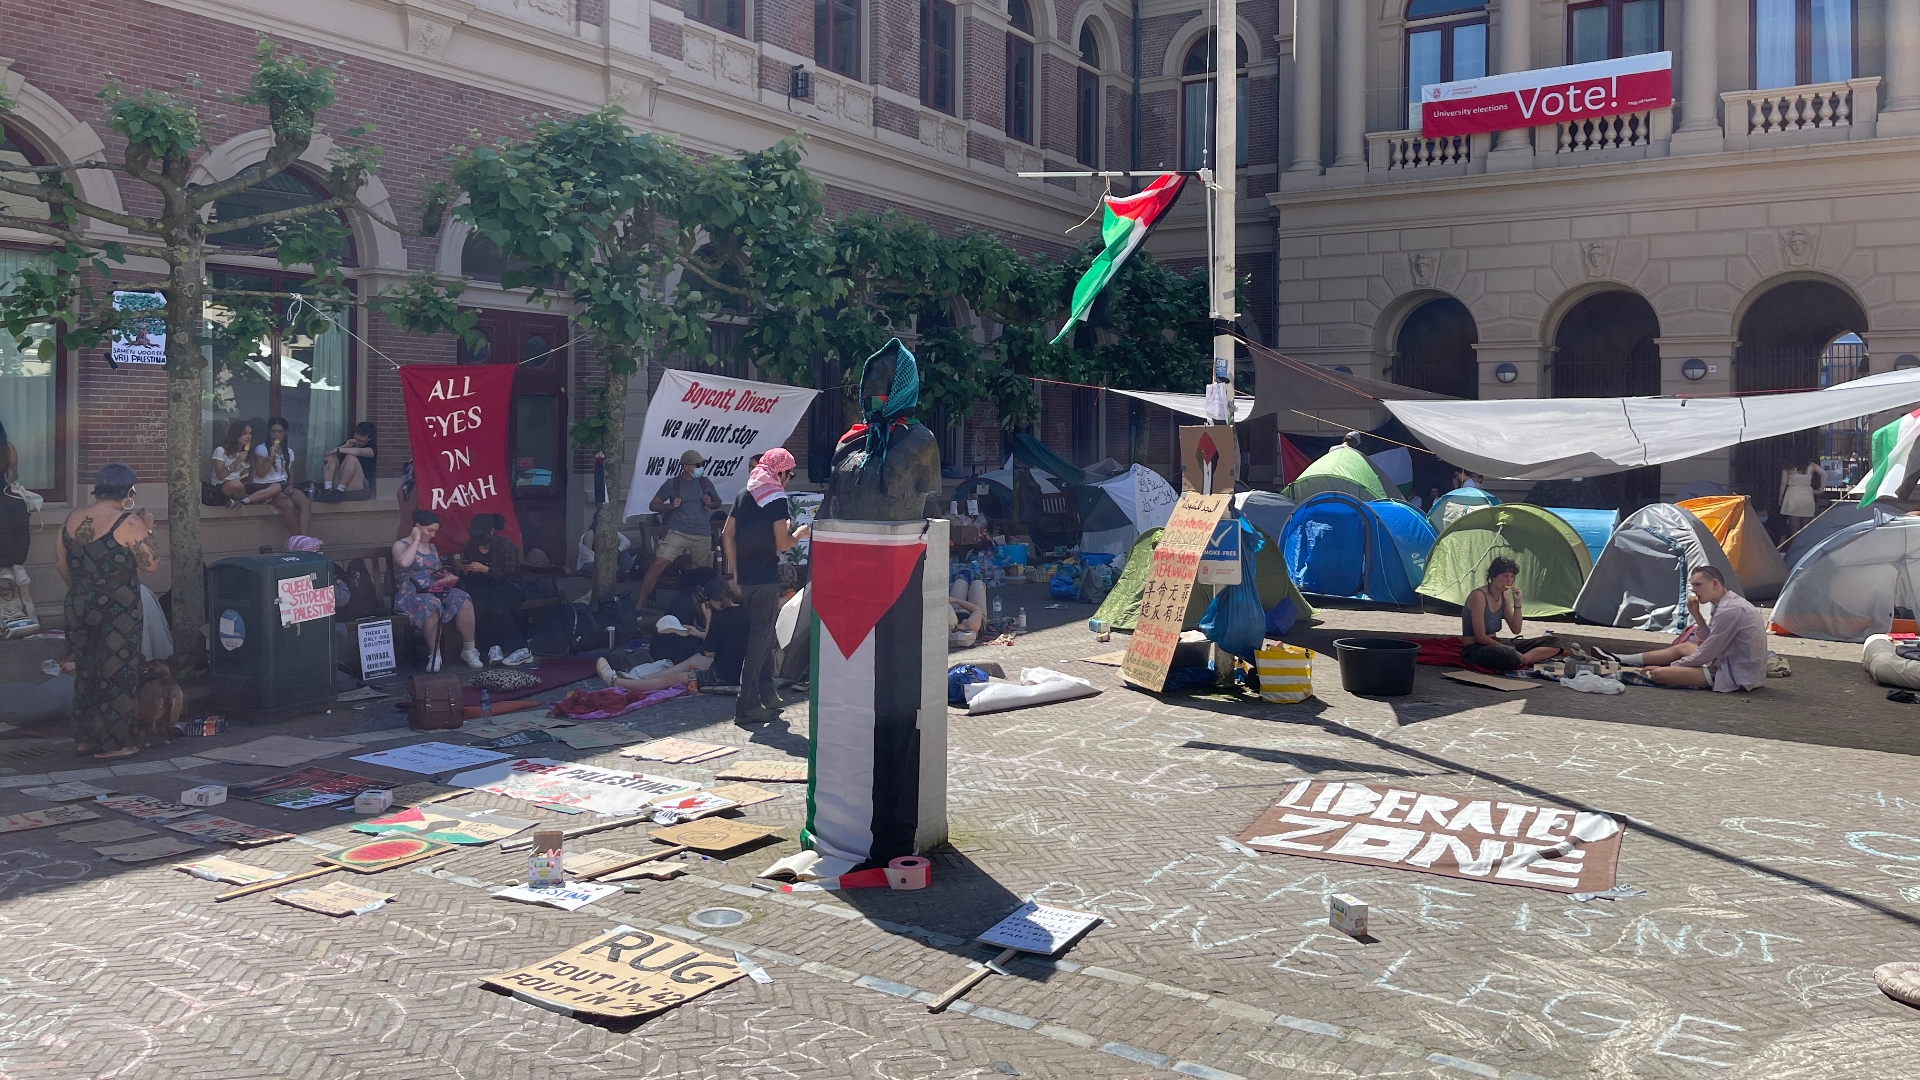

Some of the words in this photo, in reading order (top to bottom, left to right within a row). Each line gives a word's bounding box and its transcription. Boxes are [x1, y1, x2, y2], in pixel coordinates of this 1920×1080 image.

[1514, 75, 1618, 119] Vote!
[1434, 108, 1471, 118] University
[1473, 104, 1508, 114] elections
[113, 354, 129, 362] VRIJ
[131, 355, 165, 363] PALESTINA
[427, 375, 476, 402] ALL
[681, 381, 736, 413] Boycott,
[734, 389, 779, 414] Divest
[661, 418, 683, 437] we
[681, 418, 710, 441] will
[705, 423, 732, 444] not
[730, 424, 759, 449] stop
[645, 456, 665, 476] we
[710, 455, 744, 477] rest!
[1202, 549, 1237, 557] MOKE-FREE
[281, 578, 312, 596] QUEER
[290, 586, 334, 606] STUDENTS
[293, 600, 335, 621] PALESTINE
[365, 629, 381, 637] THERE
[363, 639, 391, 648] SOLUTION
[556, 768, 683, 795] PALESTINE
[1246, 813, 1586, 888] ZONE
[1012, 916, 1073, 931] HOSPITALS
[1026, 905, 1094, 922] CHILDREN
[1029, 913, 1077, 924] KILLED
[1000, 931, 1053, 944] FAMINE
[1007, 921, 1069, 936] DESTROYED
[1515, 902, 1613, 939] IS
[1635, 918, 1802, 963] NOT
[503, 971, 583, 997] FOUT
[538, 960, 617, 988] FOUT
